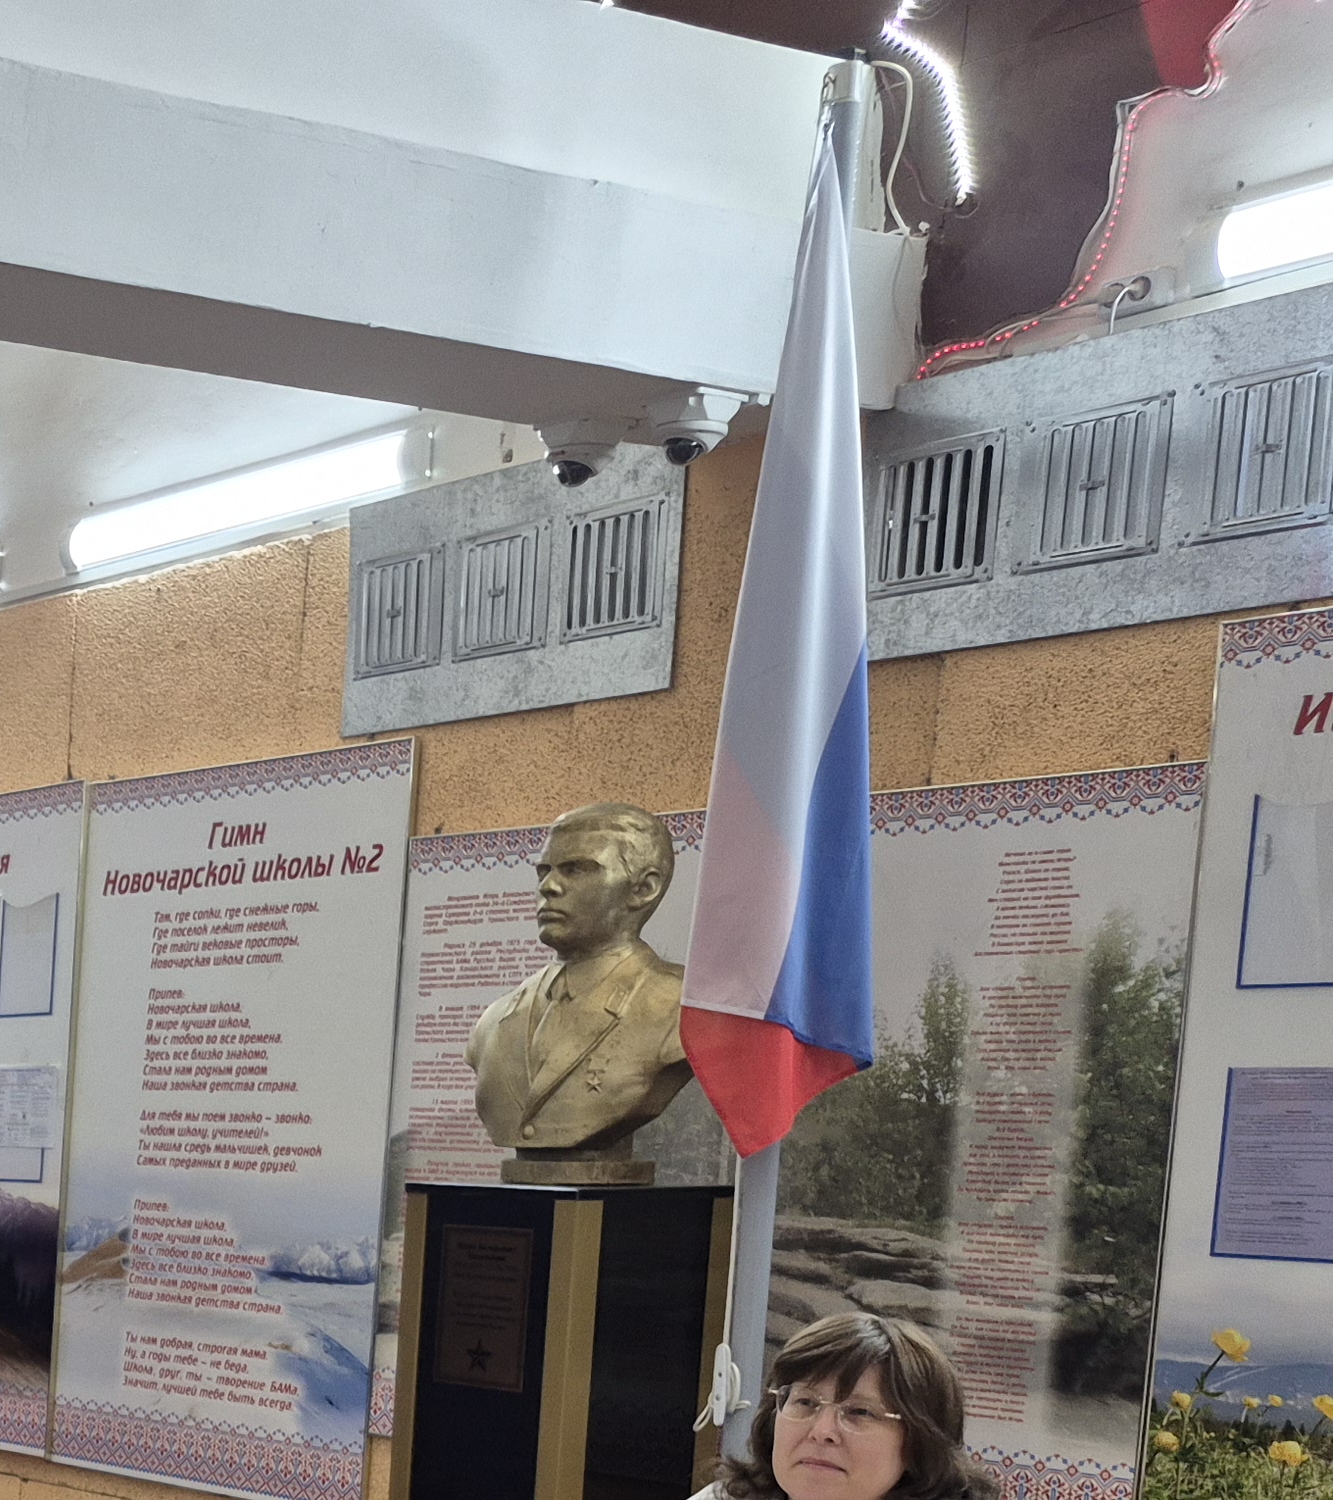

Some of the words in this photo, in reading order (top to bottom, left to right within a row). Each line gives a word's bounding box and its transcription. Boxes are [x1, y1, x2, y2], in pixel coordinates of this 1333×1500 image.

[1293, 692, 1333, 735] И
[207, 822, 267, 849] Гимн
[102, 859, 246, 896] Новочарской
[252, 853, 334, 883] школы
[341, 844, 384, 875] №2
[174, 911, 190, 923] где
[224, 907, 240, 919] где
[243, 903, 289, 916] снежные
[152, 926, 168, 940] Где
[170, 923, 207, 937] поселок
[210, 923, 243, 934] лежит
[151, 941, 167, 955] Где
[169, 939, 199, 952] тайги
[201, 936, 242, 950] вековые
[150, 954, 210, 971] Новочарская
[212, 952, 243, 966] школа
[148, 986, 185, 1001] Припев:
[147, 1001, 207, 1016] Новочарская
[154, 1020, 178, 1031] мире
[180, 1019, 216, 1031] лучшая
[170, 1032, 203, 1045] тобою
[219, 1034, 236, 1044] все
[143, 1049, 170, 1062] Здесь
[172, 1050, 188, 1060] все
[191, 1048, 223, 1060] близко
[143, 1064, 172, 1075] Стала
[174, 1066, 192, 1075] нам
[194, 1065, 232, 1077] родным
[235, 1065, 267, 1077] домом
[142, 1079, 167, 1090] Наша
[169, 1079, 207, 1090] звонкая
[209, 1081, 255, 1092] детства
[140, 1108, 156, 1120] Для
[158, 1109, 182, 1121] тебя
[201, 1112, 225, 1122] поем
[228, 1110, 262, 1122] звонко
[274, 1110, 312, 1123] звонко:
[139, 1123, 175, 1136] «Любим
[211, 1125, 268, 1140] учителей!»
[152, 1141, 181, 1152] нашла
[183, 1142, 211, 1154] средь
[273, 1143, 322, 1158] девчонок
[136, 1153, 166, 1166] Самых
[168, 1157, 221, 1170] преданных
[232, 1159, 257, 1172] мире
